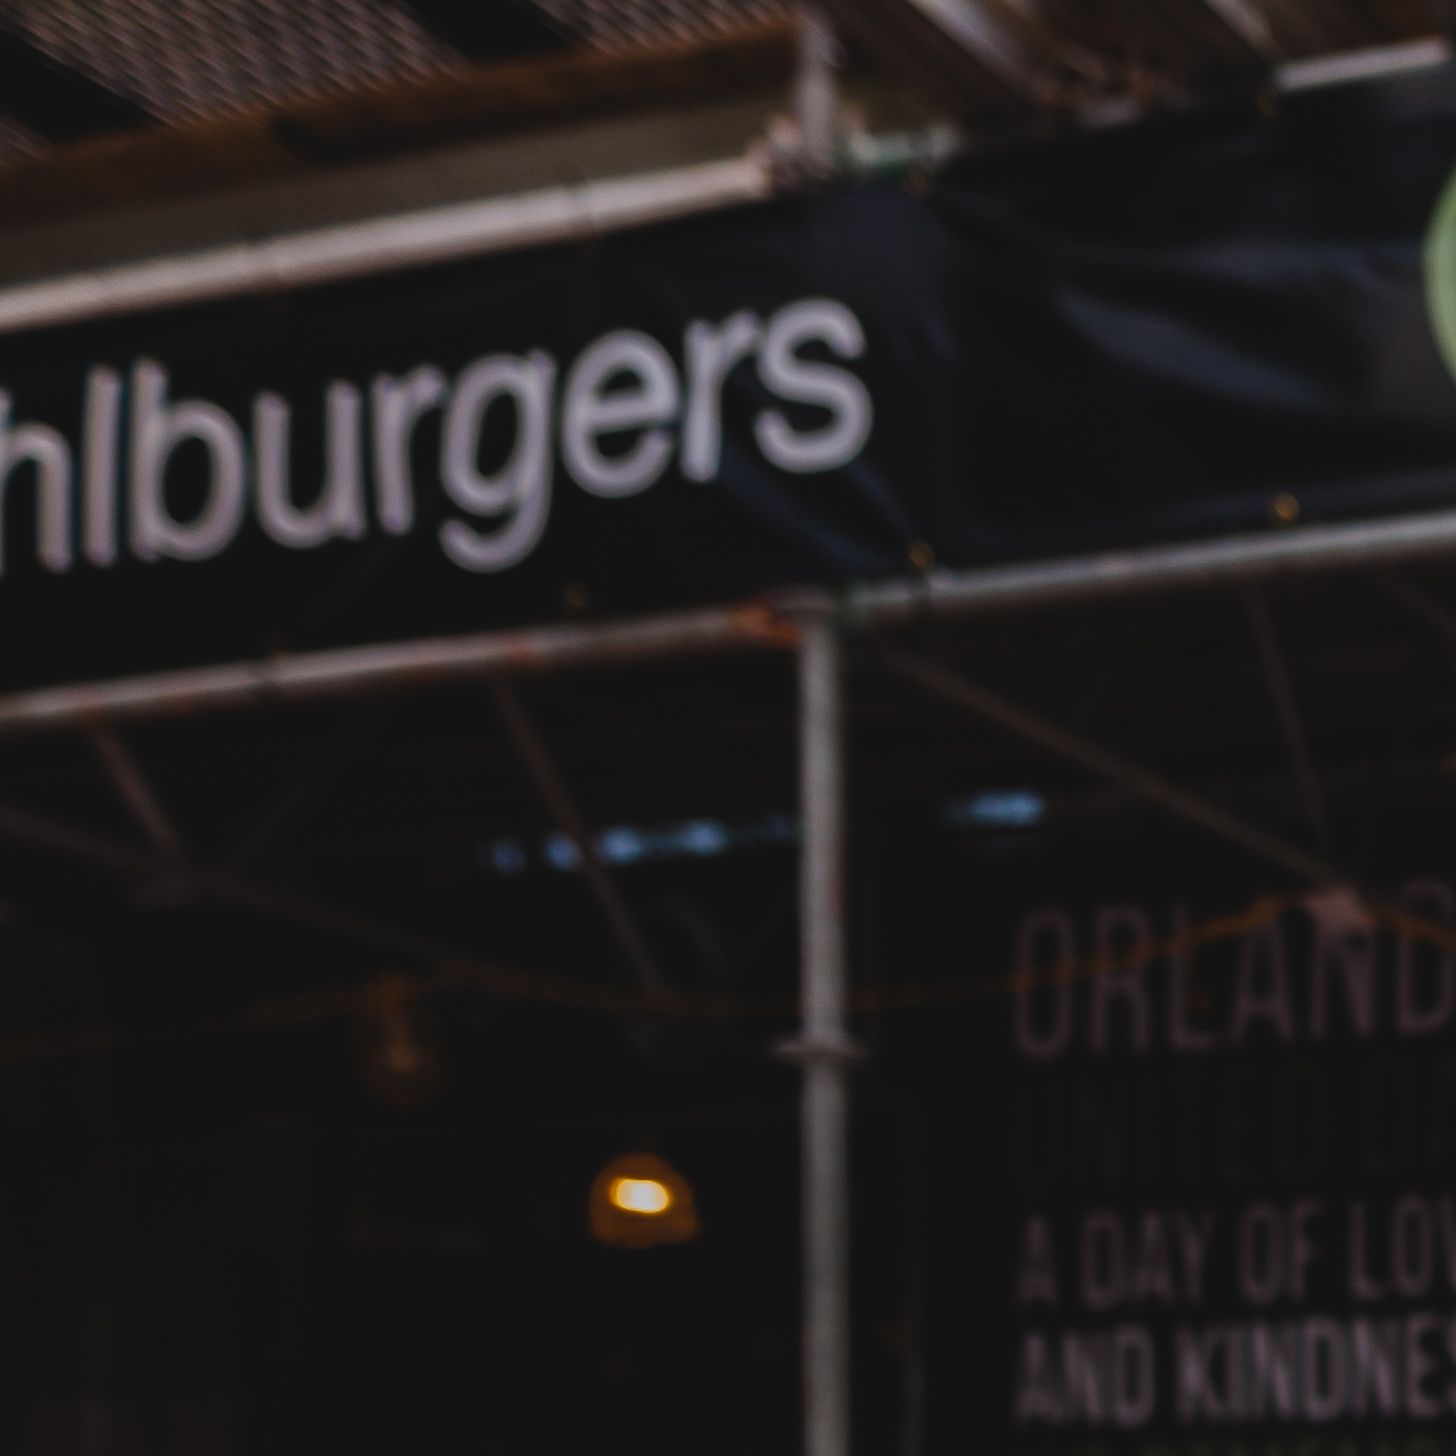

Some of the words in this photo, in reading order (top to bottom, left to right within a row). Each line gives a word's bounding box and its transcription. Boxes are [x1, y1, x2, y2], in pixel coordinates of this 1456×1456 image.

[1014, 1212, 1062, 1309] A
[1078, 1205, 1217, 1312] DAY
[1238, 1197, 1325, 1307] OF
[1013, 1325, 1158, 1431] AND
